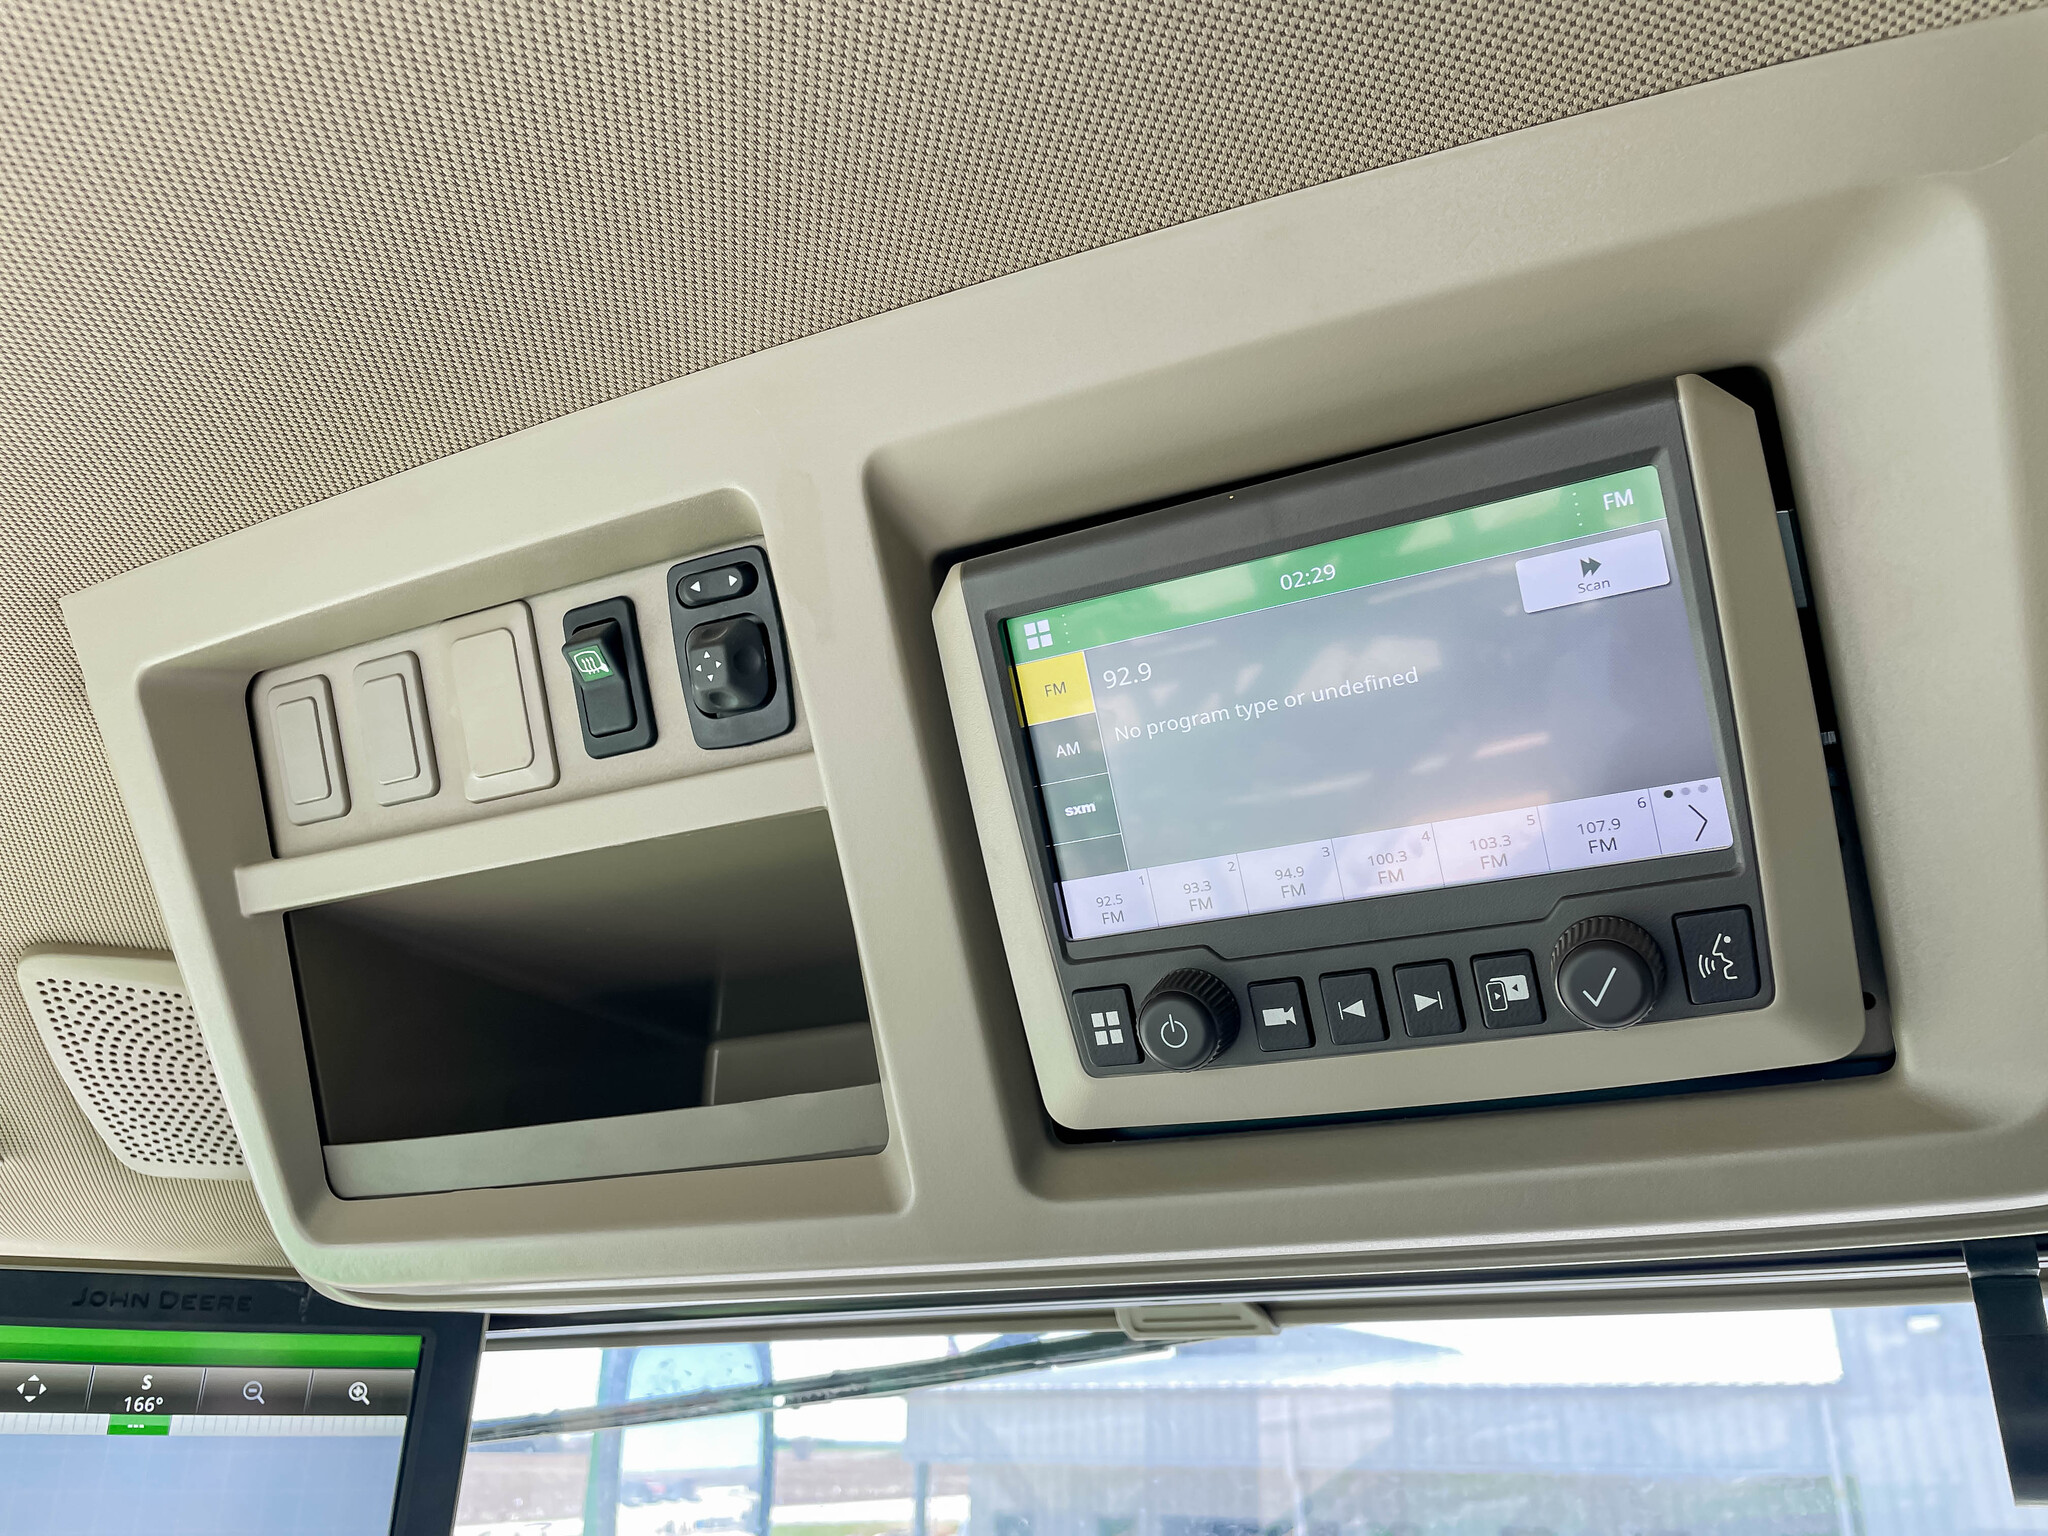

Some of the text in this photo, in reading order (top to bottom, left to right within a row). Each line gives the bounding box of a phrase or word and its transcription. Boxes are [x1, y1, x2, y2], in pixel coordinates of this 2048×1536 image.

[1602, 488, 1635, 511] FM
[1279, 563, 1337, 591] 02:29
[1576, 577, 1612, 595] Scan
[1102, 662, 1152, 689] 92.9
[1044, 681, 1068, 698] FM
[1114, 665, 1420, 742] No program type or undefined
[1055, 740, 1082, 759] AM
[1064, 801, 1097, 817] sxm
[1637, 796, 1647, 809] 6
[1526, 814, 1536, 827] 5
[1576, 817, 1622, 836] 107.9
[1421, 830, 1431, 843] 4
[1469, 834, 1512, 852] 103.3
[1321, 846, 1331, 858] 3
[1587, 836, 1618, 855] FM
[1227, 861, 1237, 873] 2
[1366, 850, 1408, 867] 100.3
[1479, 852, 1509, 871] FM
[1138, 875, 1146, 887] 1
[1273, 866, 1306, 881] 94.9
[1377, 867, 1406, 885] FM
[1182, 880, 1213, 895] 93.3
[1280, 882, 1307, 899] FM
[1095, 893, 1124, 908] 92.5
[1188, 896, 1214, 912] FM
[1101, 909, 1126, 925] FM
[71, 1286, 254, 1312] JOHN DEERE
[141, 1374, 154, 1391] S
